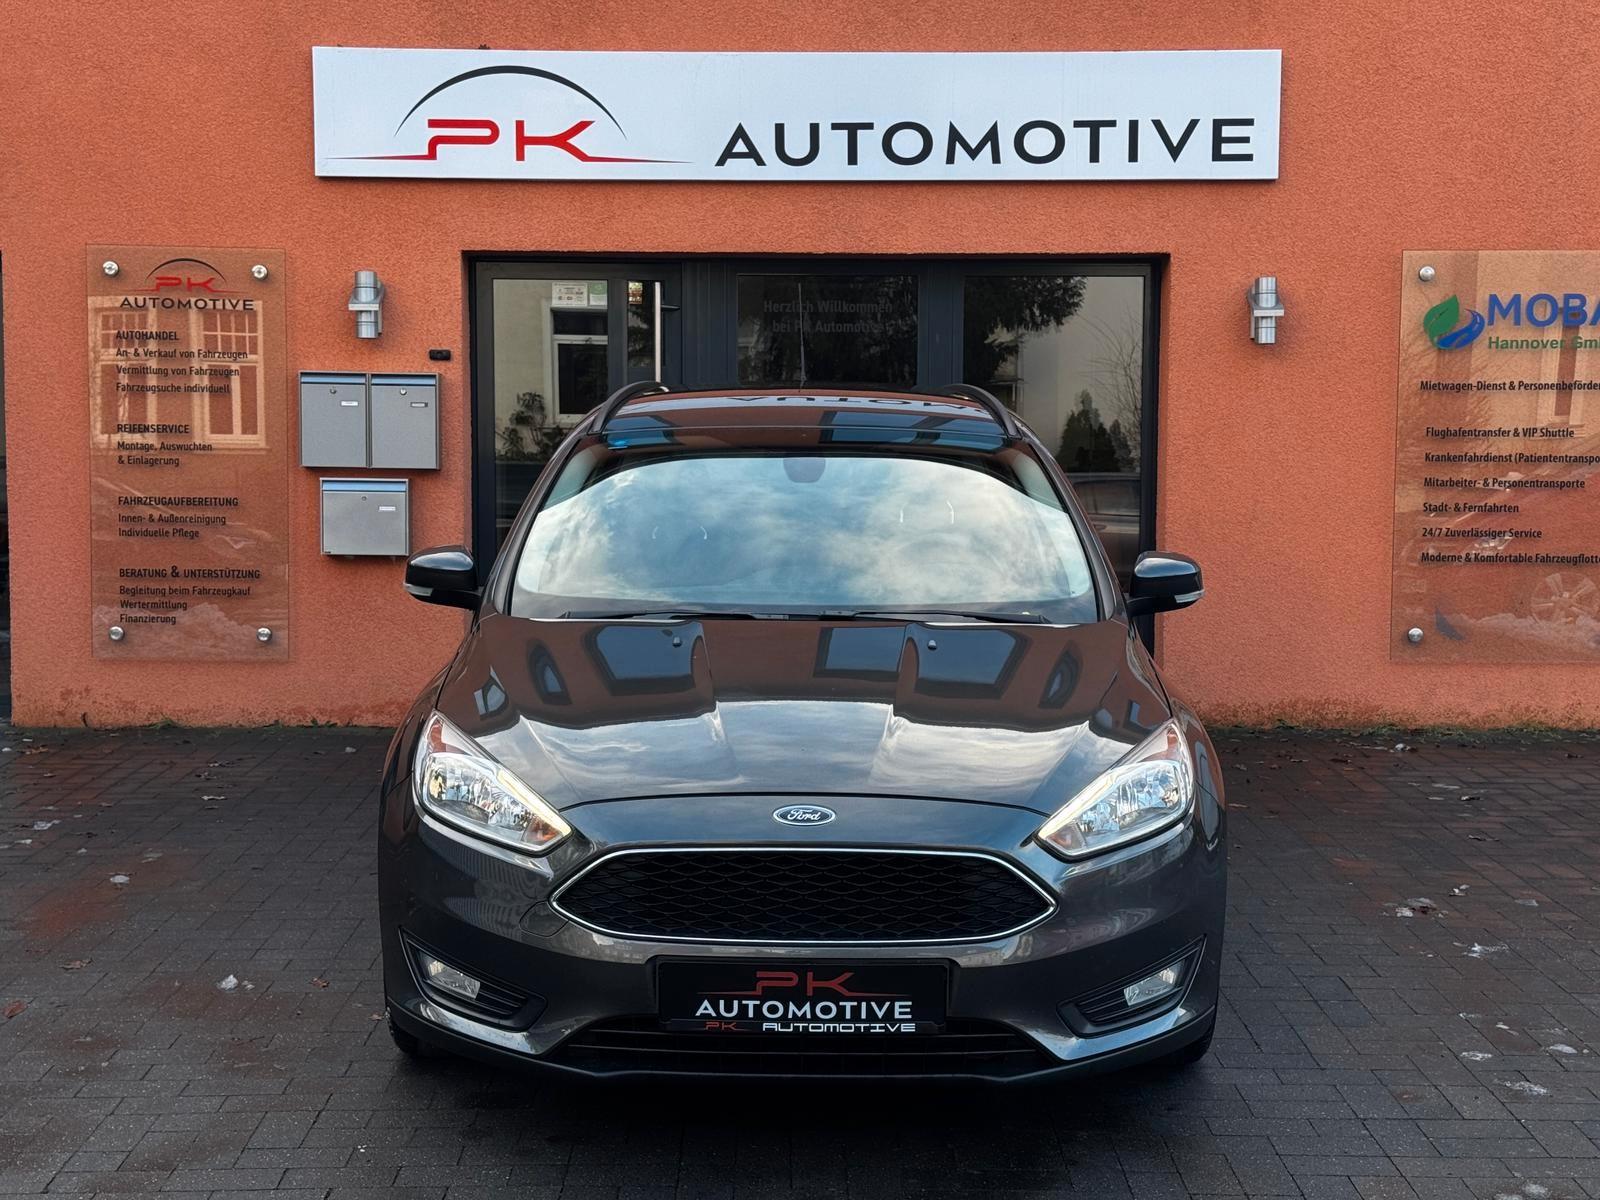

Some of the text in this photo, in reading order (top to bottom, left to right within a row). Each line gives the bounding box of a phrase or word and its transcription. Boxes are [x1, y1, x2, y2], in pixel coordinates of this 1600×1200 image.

[428, 117, 1254, 167] PK AUTOMOTIVE
[156, 276, 215, 292] PK
[120, 297, 254, 311] AUTOMOTIVE
[764, 300, 893, 313] Herzlich Willkommen
[116, 330, 180, 341] AUTOHANDEL
[1488, 336, 1600, 350] Hannover Gm
[116, 348, 248, 361] An- & Verkauf von Fahrzeugen
[116, 365, 240, 378] Vermittlung von Fahrzeugen
[116, 383, 230, 394] Fahrzeugsuche individuell
[1420, 380, 1506, 393] Mietwagen-Dienst
[1508, 381, 1516, 391] &
[117, 424, 190, 434] REIFENSERVICE
[1426, 426, 1574, 440] Flughafentransfer & VIP Shuttle
[160, 442, 212, 452] Auswuchten
[118, 456, 180, 468] & Einlagerung
[1424, 452, 1512, 463] Krankenfahrdienst
[1424, 477, 1586, 490] Mitarbeiter- & Personentransporte
[118, 496, 239, 507] FAHRZEUGAUFBEREITUNG
[1423, 502, 1520, 513] Stadt- & Fernfahrten
[118, 514, 226, 526] Innen- & Außenreinigung
[118, 528, 200, 540] Individuelle Pflege
[1422, 526, 1542, 540] 24/7 Zuverlässiger Service
[1421, 552, 1462, 562] Moderne
[1464, 553, 1472, 562] &
[1474, 552, 1533, 563] Komfortable
[119, 565, 261, 580] BERATUNG & UNTERSTÜTZUNG
[120, 586, 250, 598] Begleitung beim Fahrzeugkauf
[120, 600, 188, 612] Wertermittlung
[120, 614, 176, 626] Finanzierung
[787, 808, 821, 820] Ford
[756, 971, 854, 996] PK
[695, 999, 912, 1020] AUTOMOTIVE
[704, 1022, 916, 1032] PK AUTOMOTIVE
